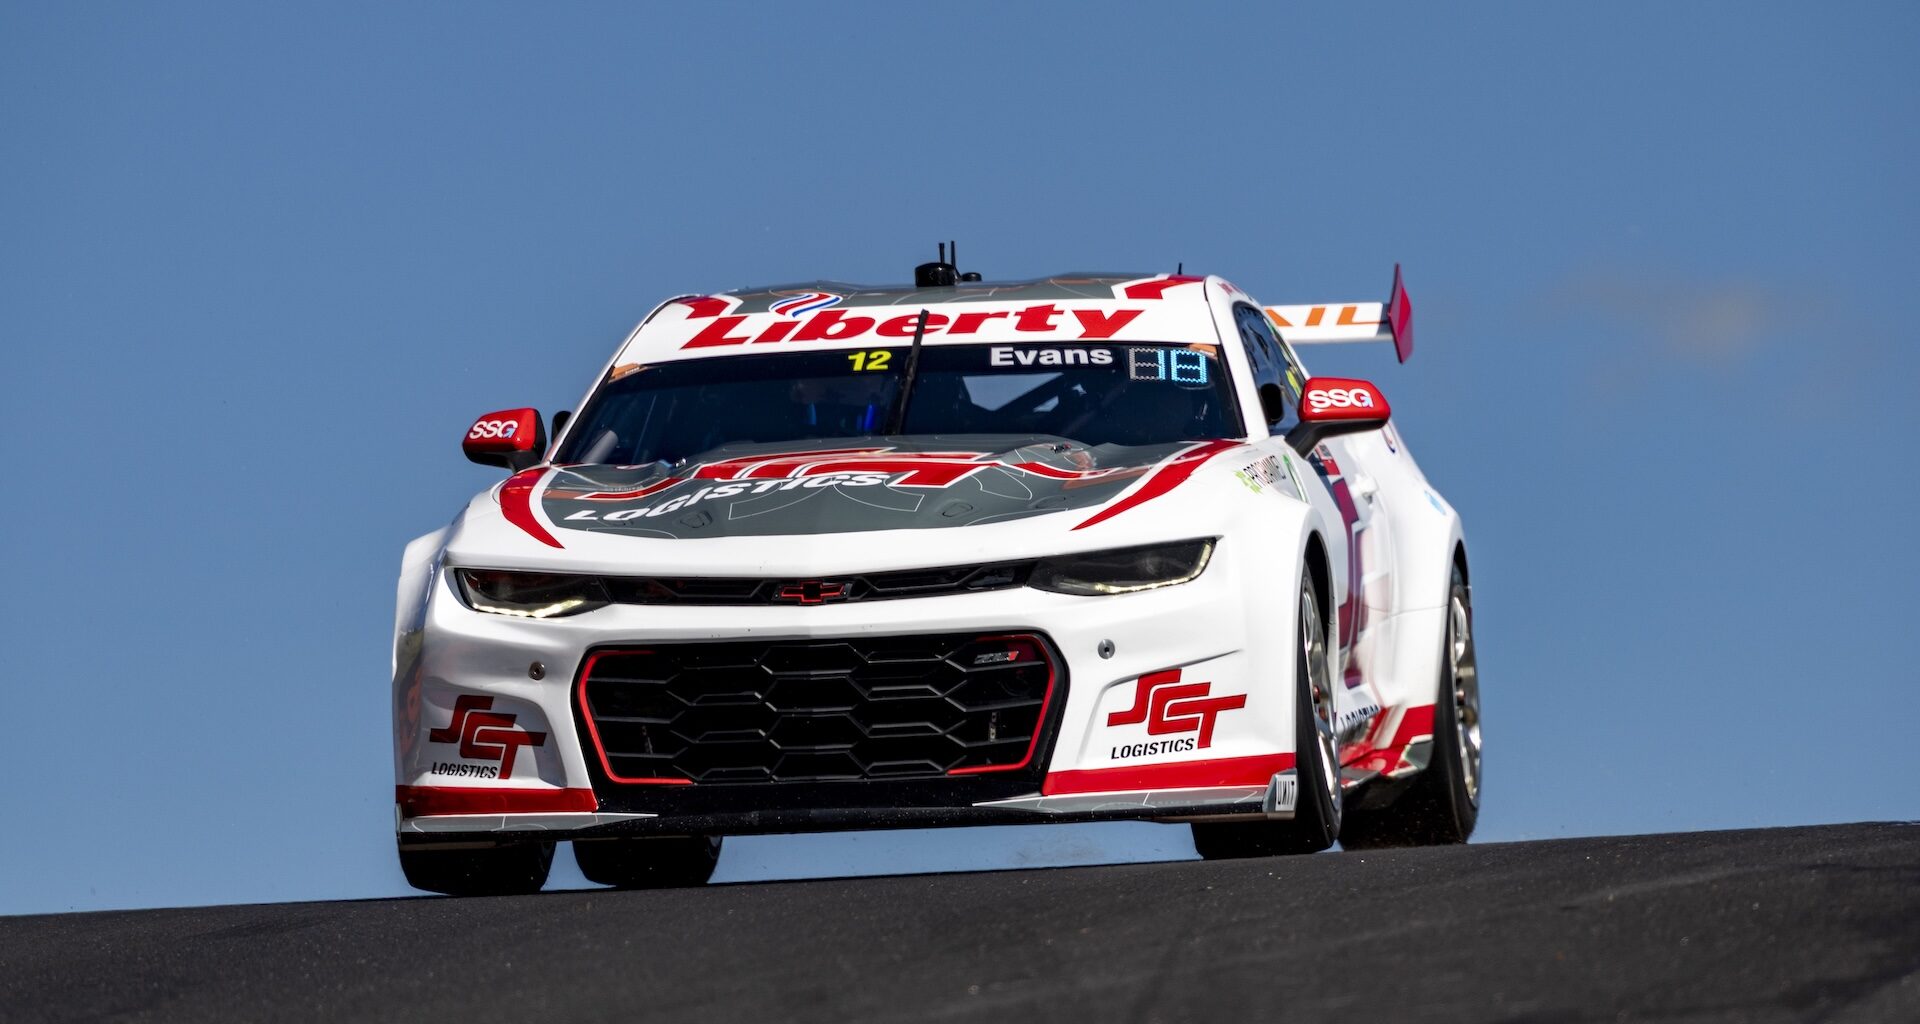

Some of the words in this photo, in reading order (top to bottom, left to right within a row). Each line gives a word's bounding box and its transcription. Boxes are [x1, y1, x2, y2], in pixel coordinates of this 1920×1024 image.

[680, 304, 1144, 350] Liberty
[848, 350, 892, 371] 12
[990, 346, 1113, 366] Evans
[1308, 388, 1374, 409] SSG
[469, 420, 518, 439] SSG
[564, 475, 884, 522] LOGISTICS
[1107, 669, 1247, 749] SCT
[429, 695, 547, 779] SCT
[1111, 738, 1195, 760] LOGISTICS
[431, 762, 498, 778] LOGISTICS
